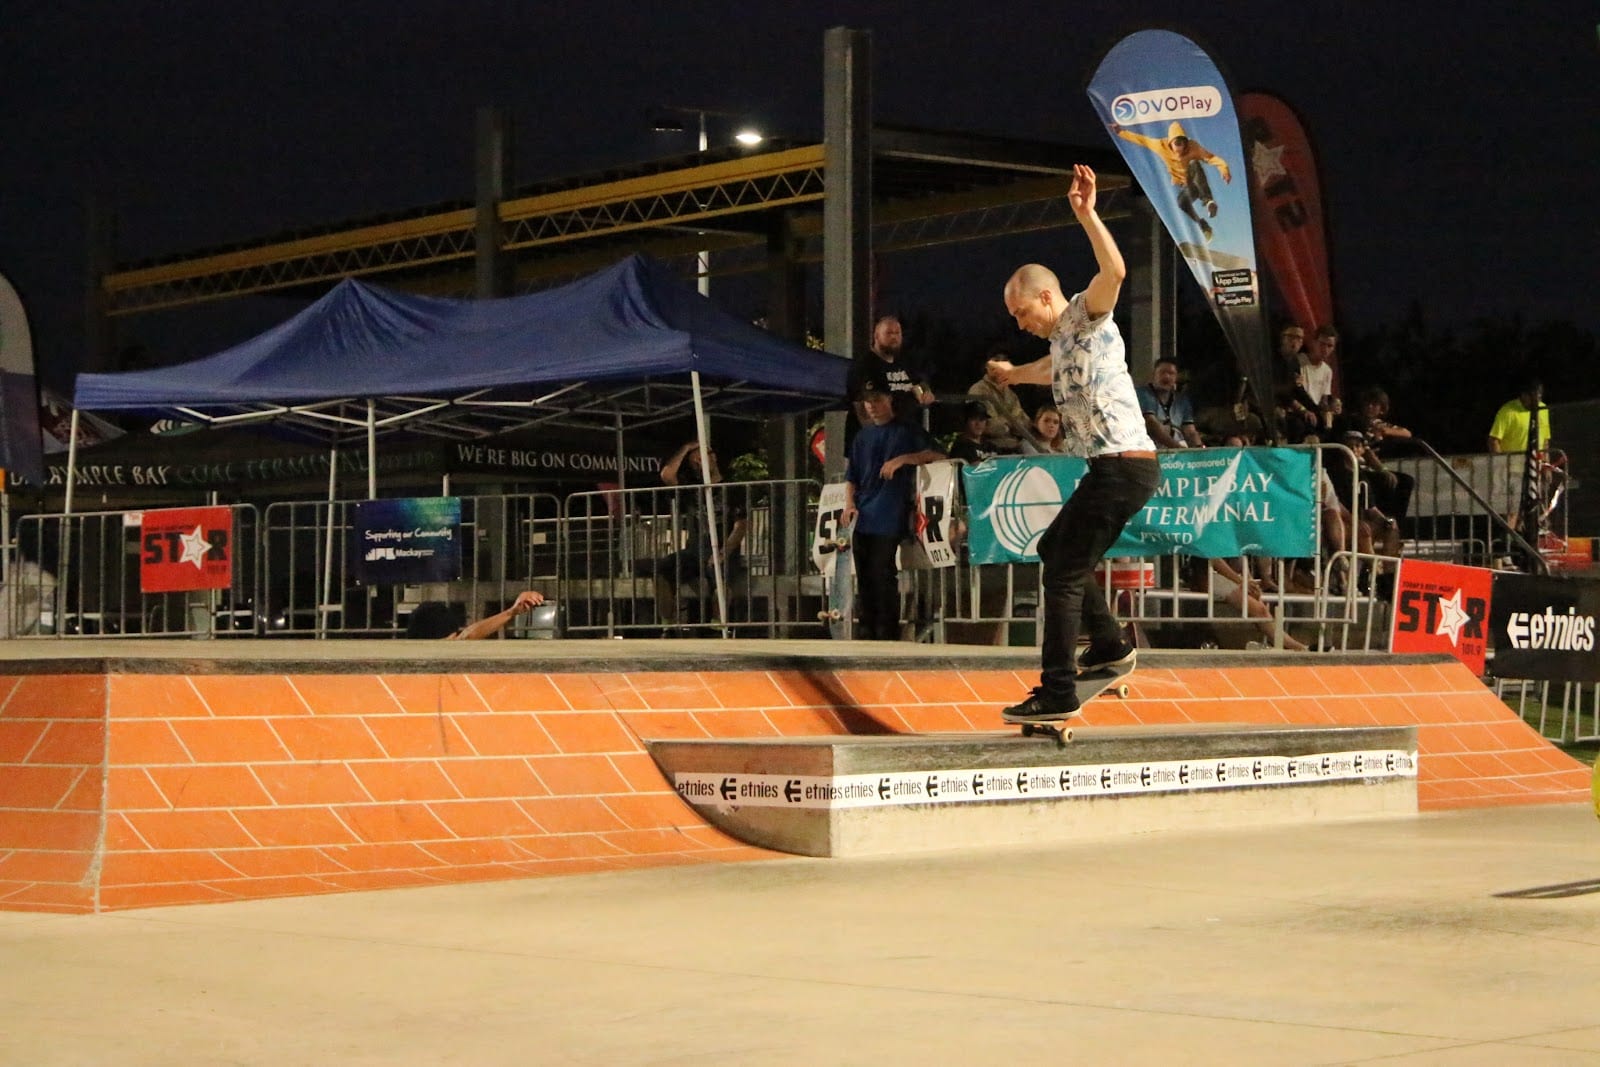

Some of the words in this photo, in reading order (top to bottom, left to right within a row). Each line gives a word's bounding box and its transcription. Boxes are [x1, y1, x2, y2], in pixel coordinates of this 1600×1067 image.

[457, 442, 507, 465] WE'RE
[511, 449, 538, 468] BIG
[541, 451, 567, 469] ON
[570, 453, 661, 473] COMMUNITY
[1187, 458, 1226, 471] sponsored
[132, 464, 171, 486] BAY
[1529, 605, 1595, 651] etnies
[677, 779, 715, 798] etnies
[741, 780, 779, 798] etnies
[806, 783, 843, 801] etnies
[844, 781, 874, 800] etnies
[893, 778, 922, 796] etnies
[941, 775, 968, 793] etnies
[986, 772, 1013, 791] etnies
[1030, 769, 1056, 790] etnies
[1072, 767, 1098, 788] etnies
[1113, 766, 1137, 785] etnies
[1152, 763, 1176, 783] etnies
[1190, 762, 1213, 780] etnies
[1263, 759, 1285, 777] etnies
